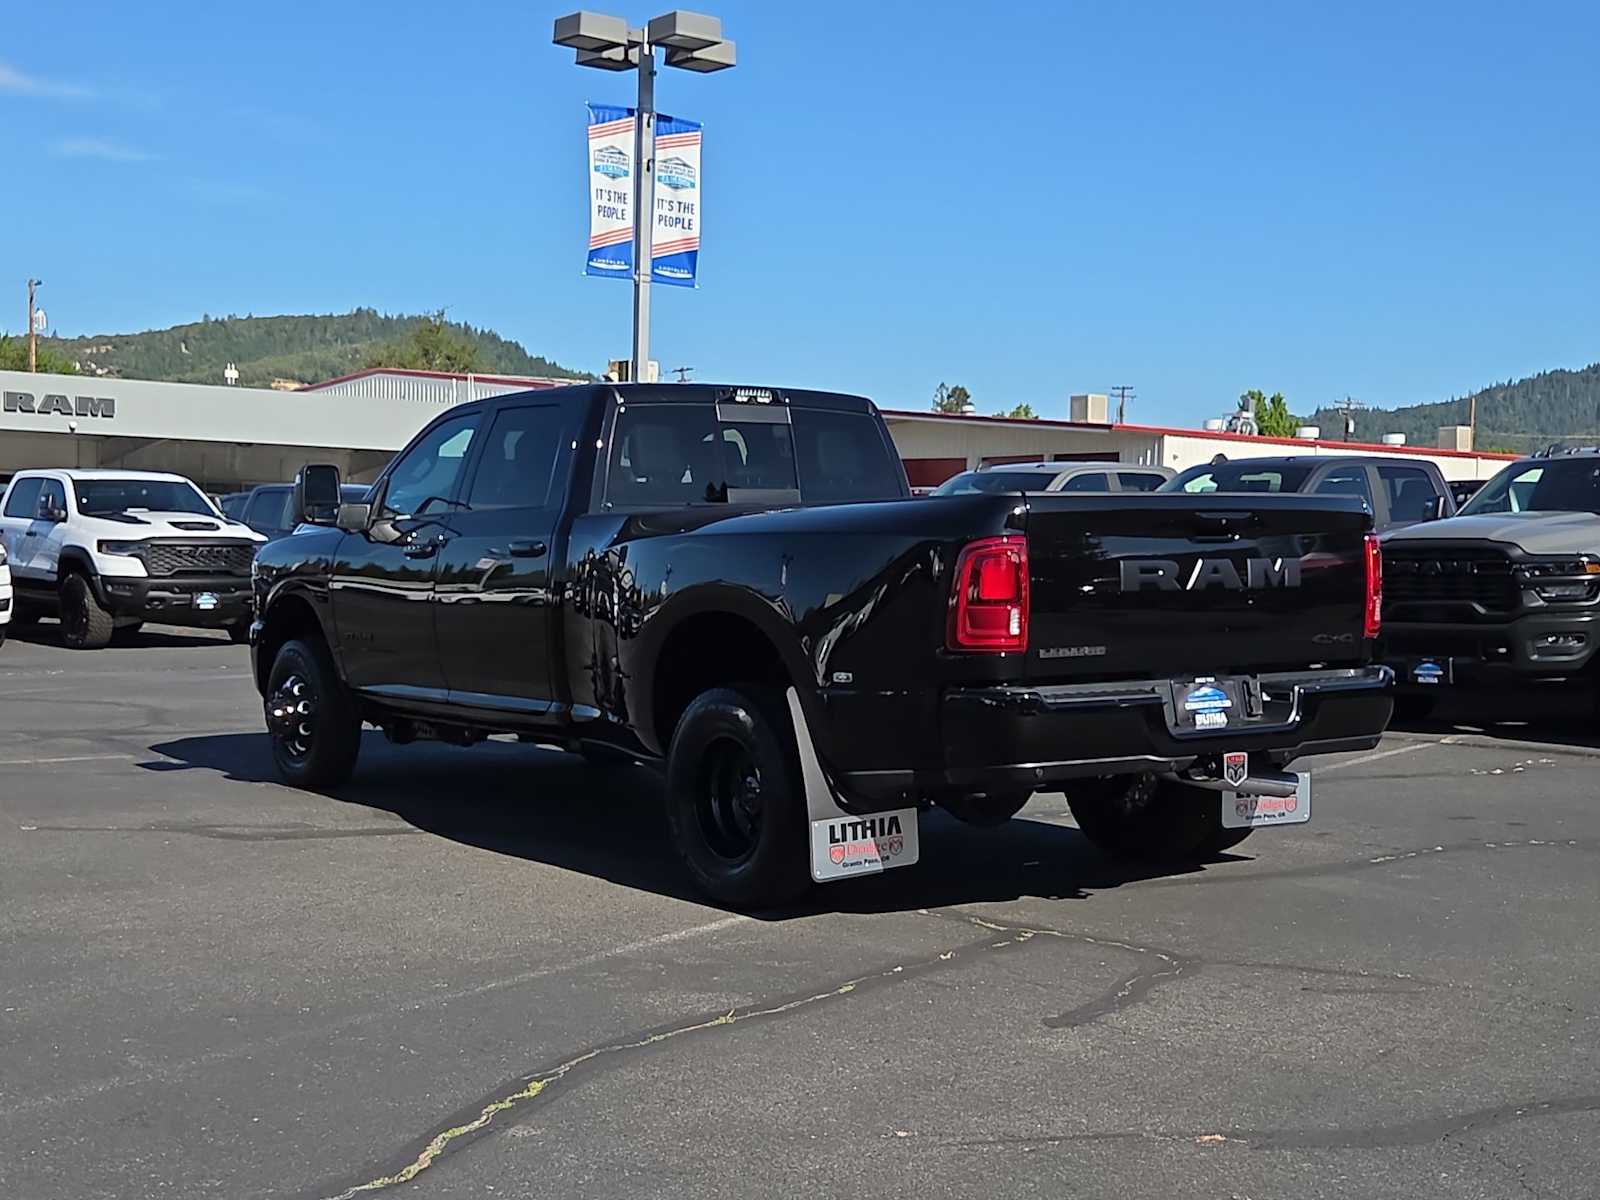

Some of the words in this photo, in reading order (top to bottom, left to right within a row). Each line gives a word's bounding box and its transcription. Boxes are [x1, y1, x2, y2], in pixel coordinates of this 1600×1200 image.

[596, 188, 612, 202] IT'S
[613, 191, 628, 205] THE
[597, 204, 627, 220] PEOPLE
[657, 198, 674, 212] IT'S
[677, 201, 695, 215] THE
[658, 214, 693, 230] PEOPLE
[3, 391, 115, 418] RAM
[1119, 557, 1302, 592] RAM
[829, 815, 902, 844] LITHIA
